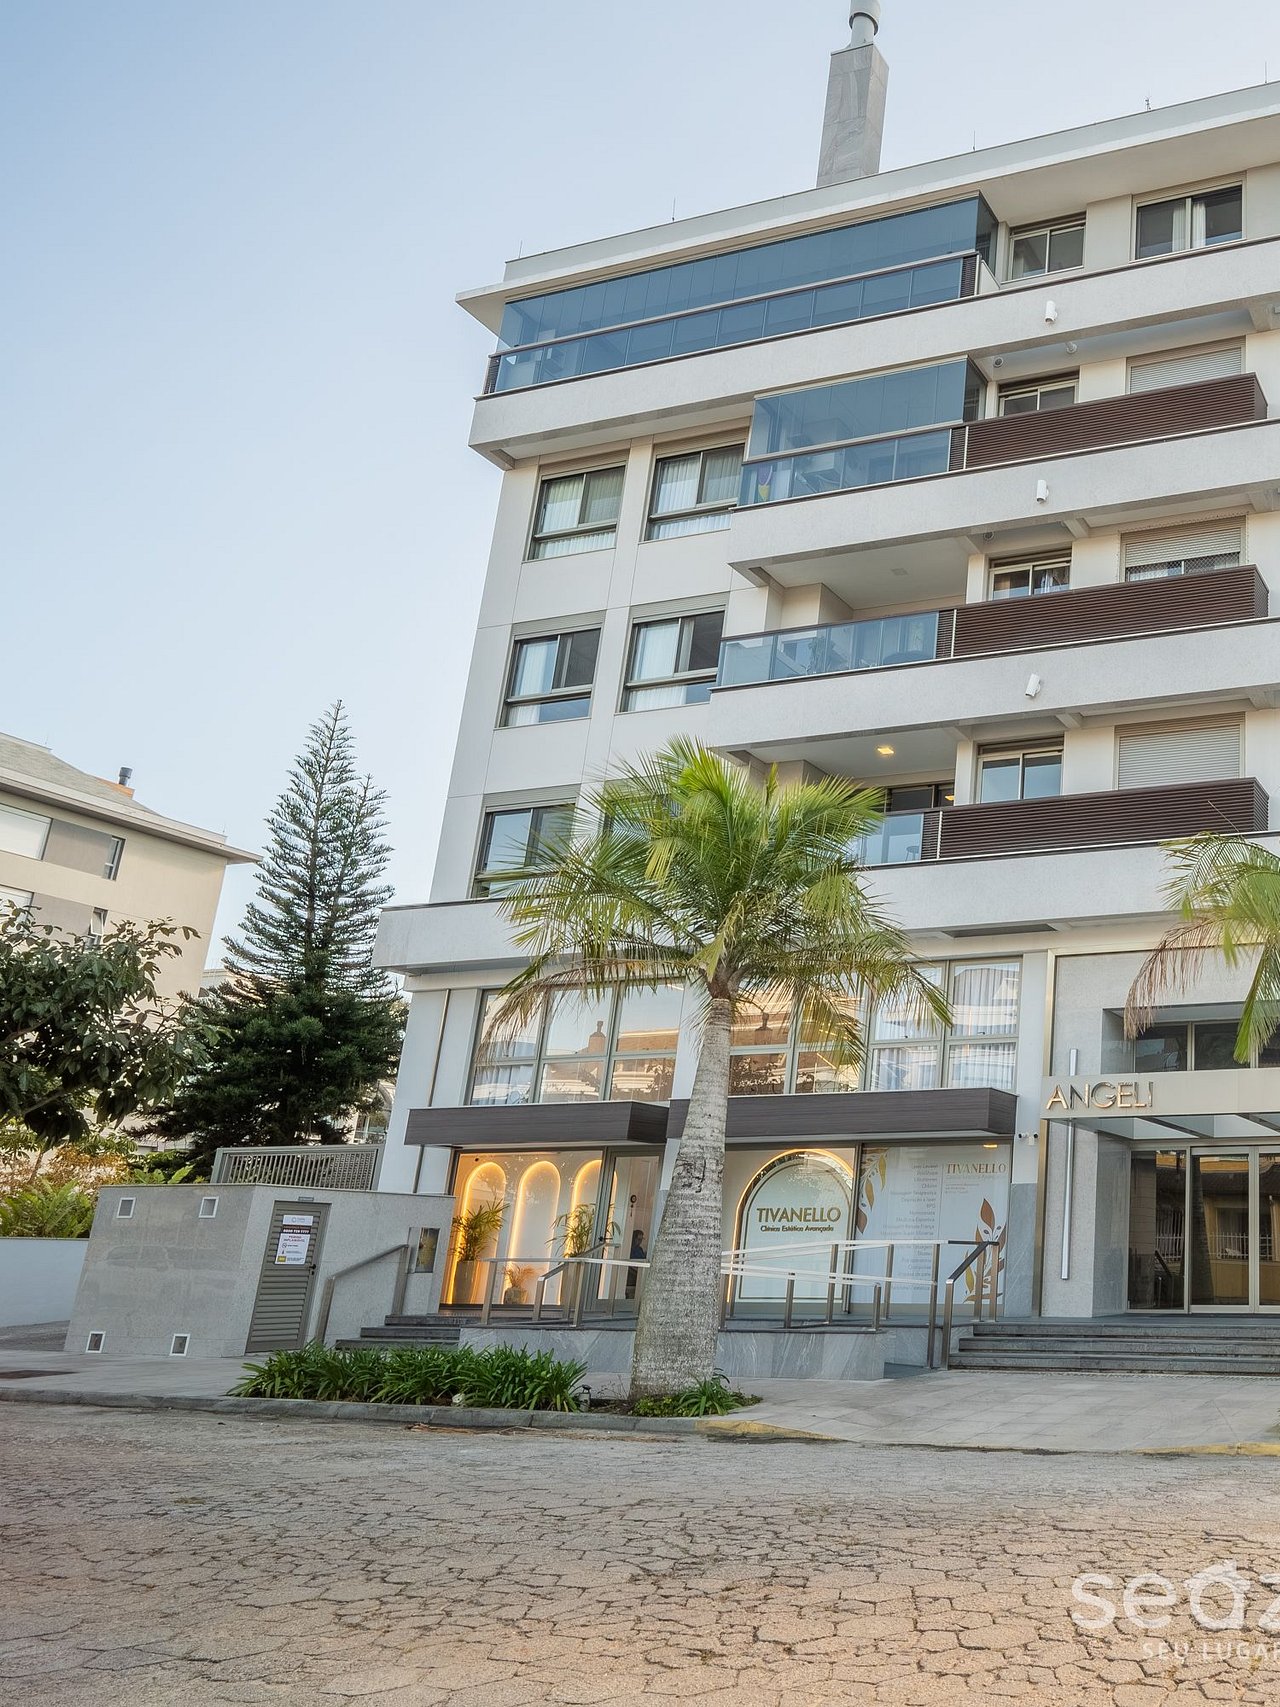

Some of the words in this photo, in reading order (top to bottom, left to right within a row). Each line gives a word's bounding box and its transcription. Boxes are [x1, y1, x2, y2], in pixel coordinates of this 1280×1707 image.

[1045, 1081, 1155, 1110] ANGELI
[946, 1162, 1007, 1175] TIVANELLO
[756, 1206, 842, 1223] TIVANELLO
